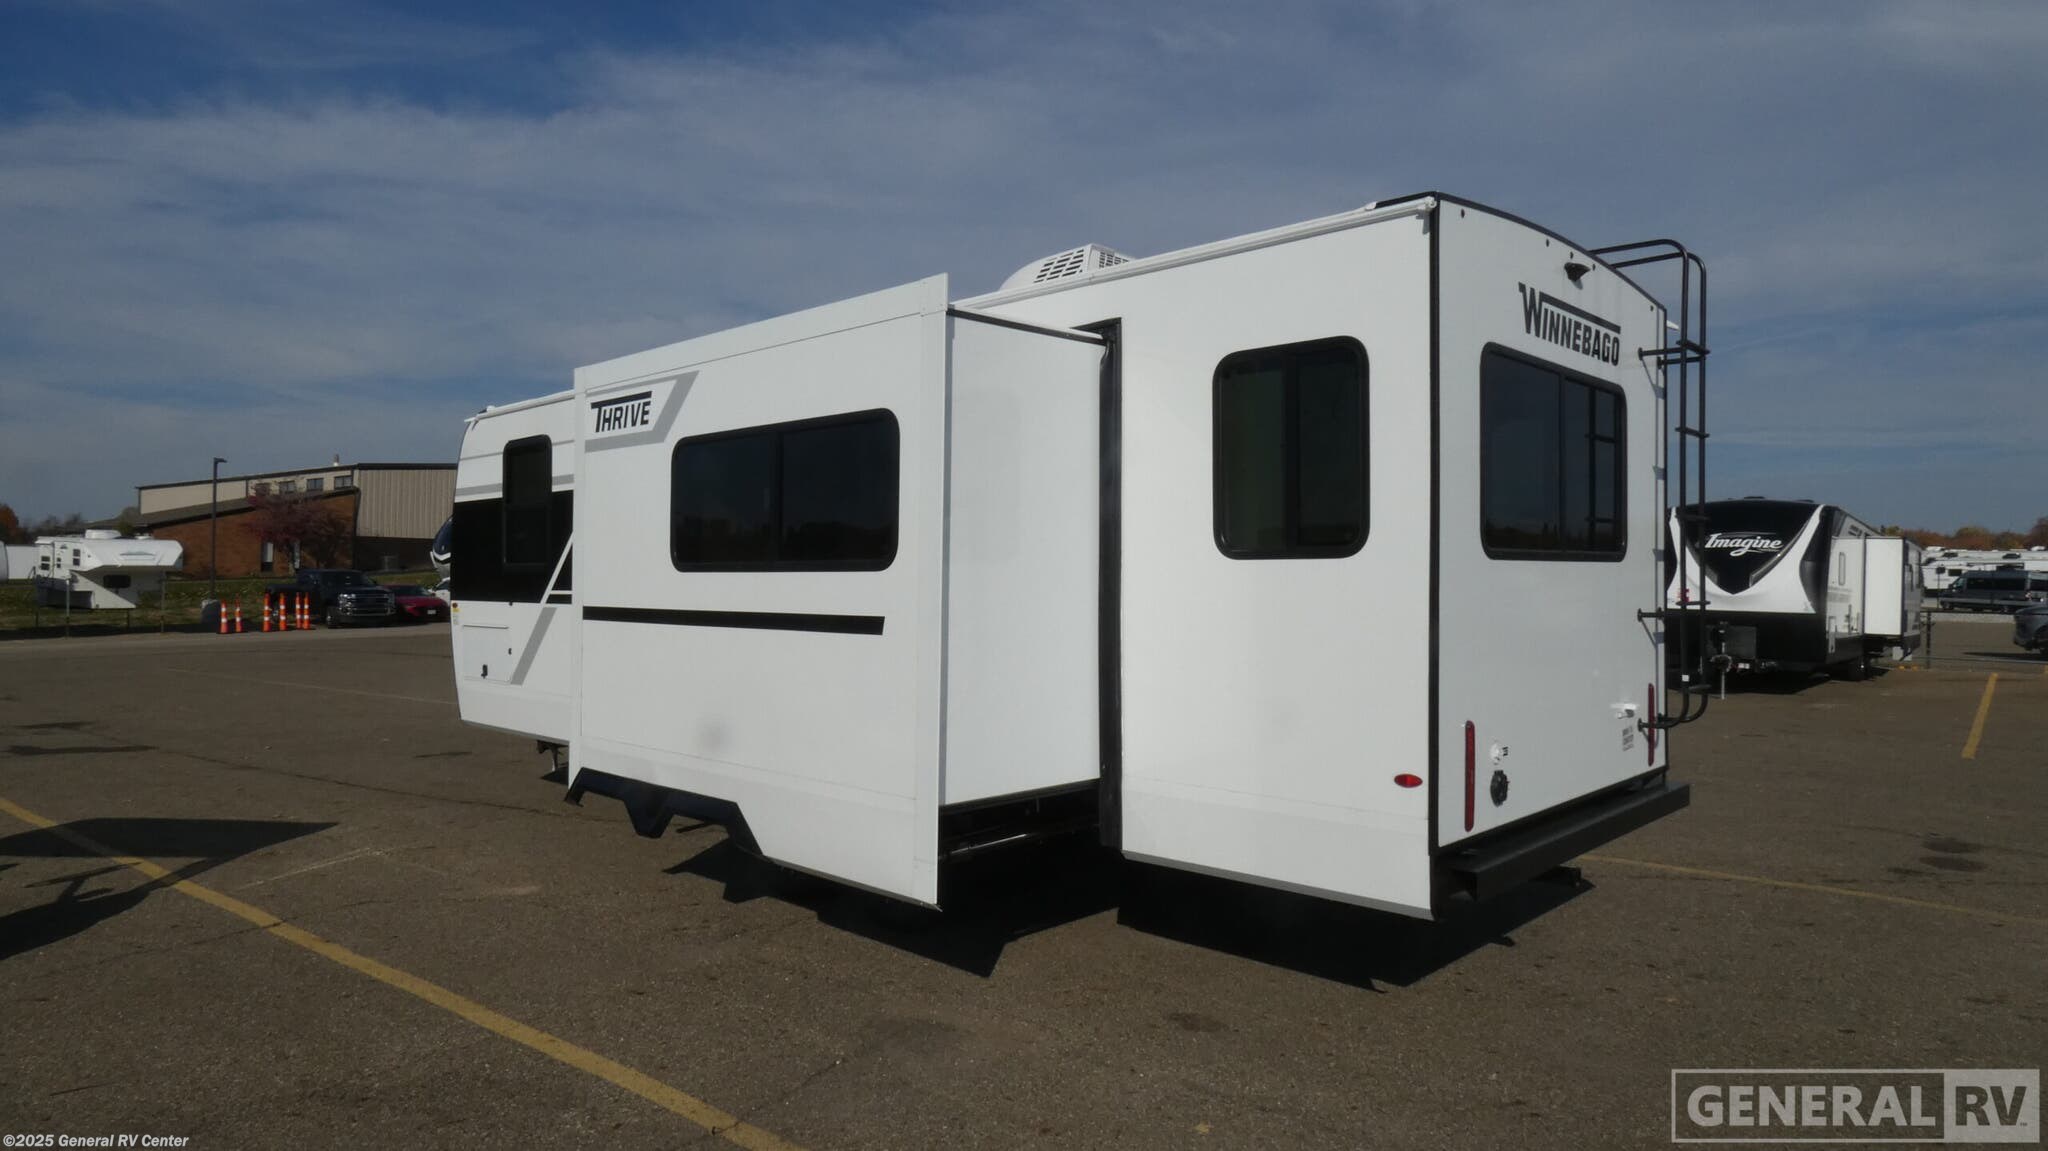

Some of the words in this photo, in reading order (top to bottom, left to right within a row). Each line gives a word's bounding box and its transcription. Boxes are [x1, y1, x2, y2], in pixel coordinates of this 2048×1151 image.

[1518, 281, 1621, 367] WINNEBAGO
[590, 390, 652, 433] THRIVE
[1704, 532, 1784, 557] Imagine
